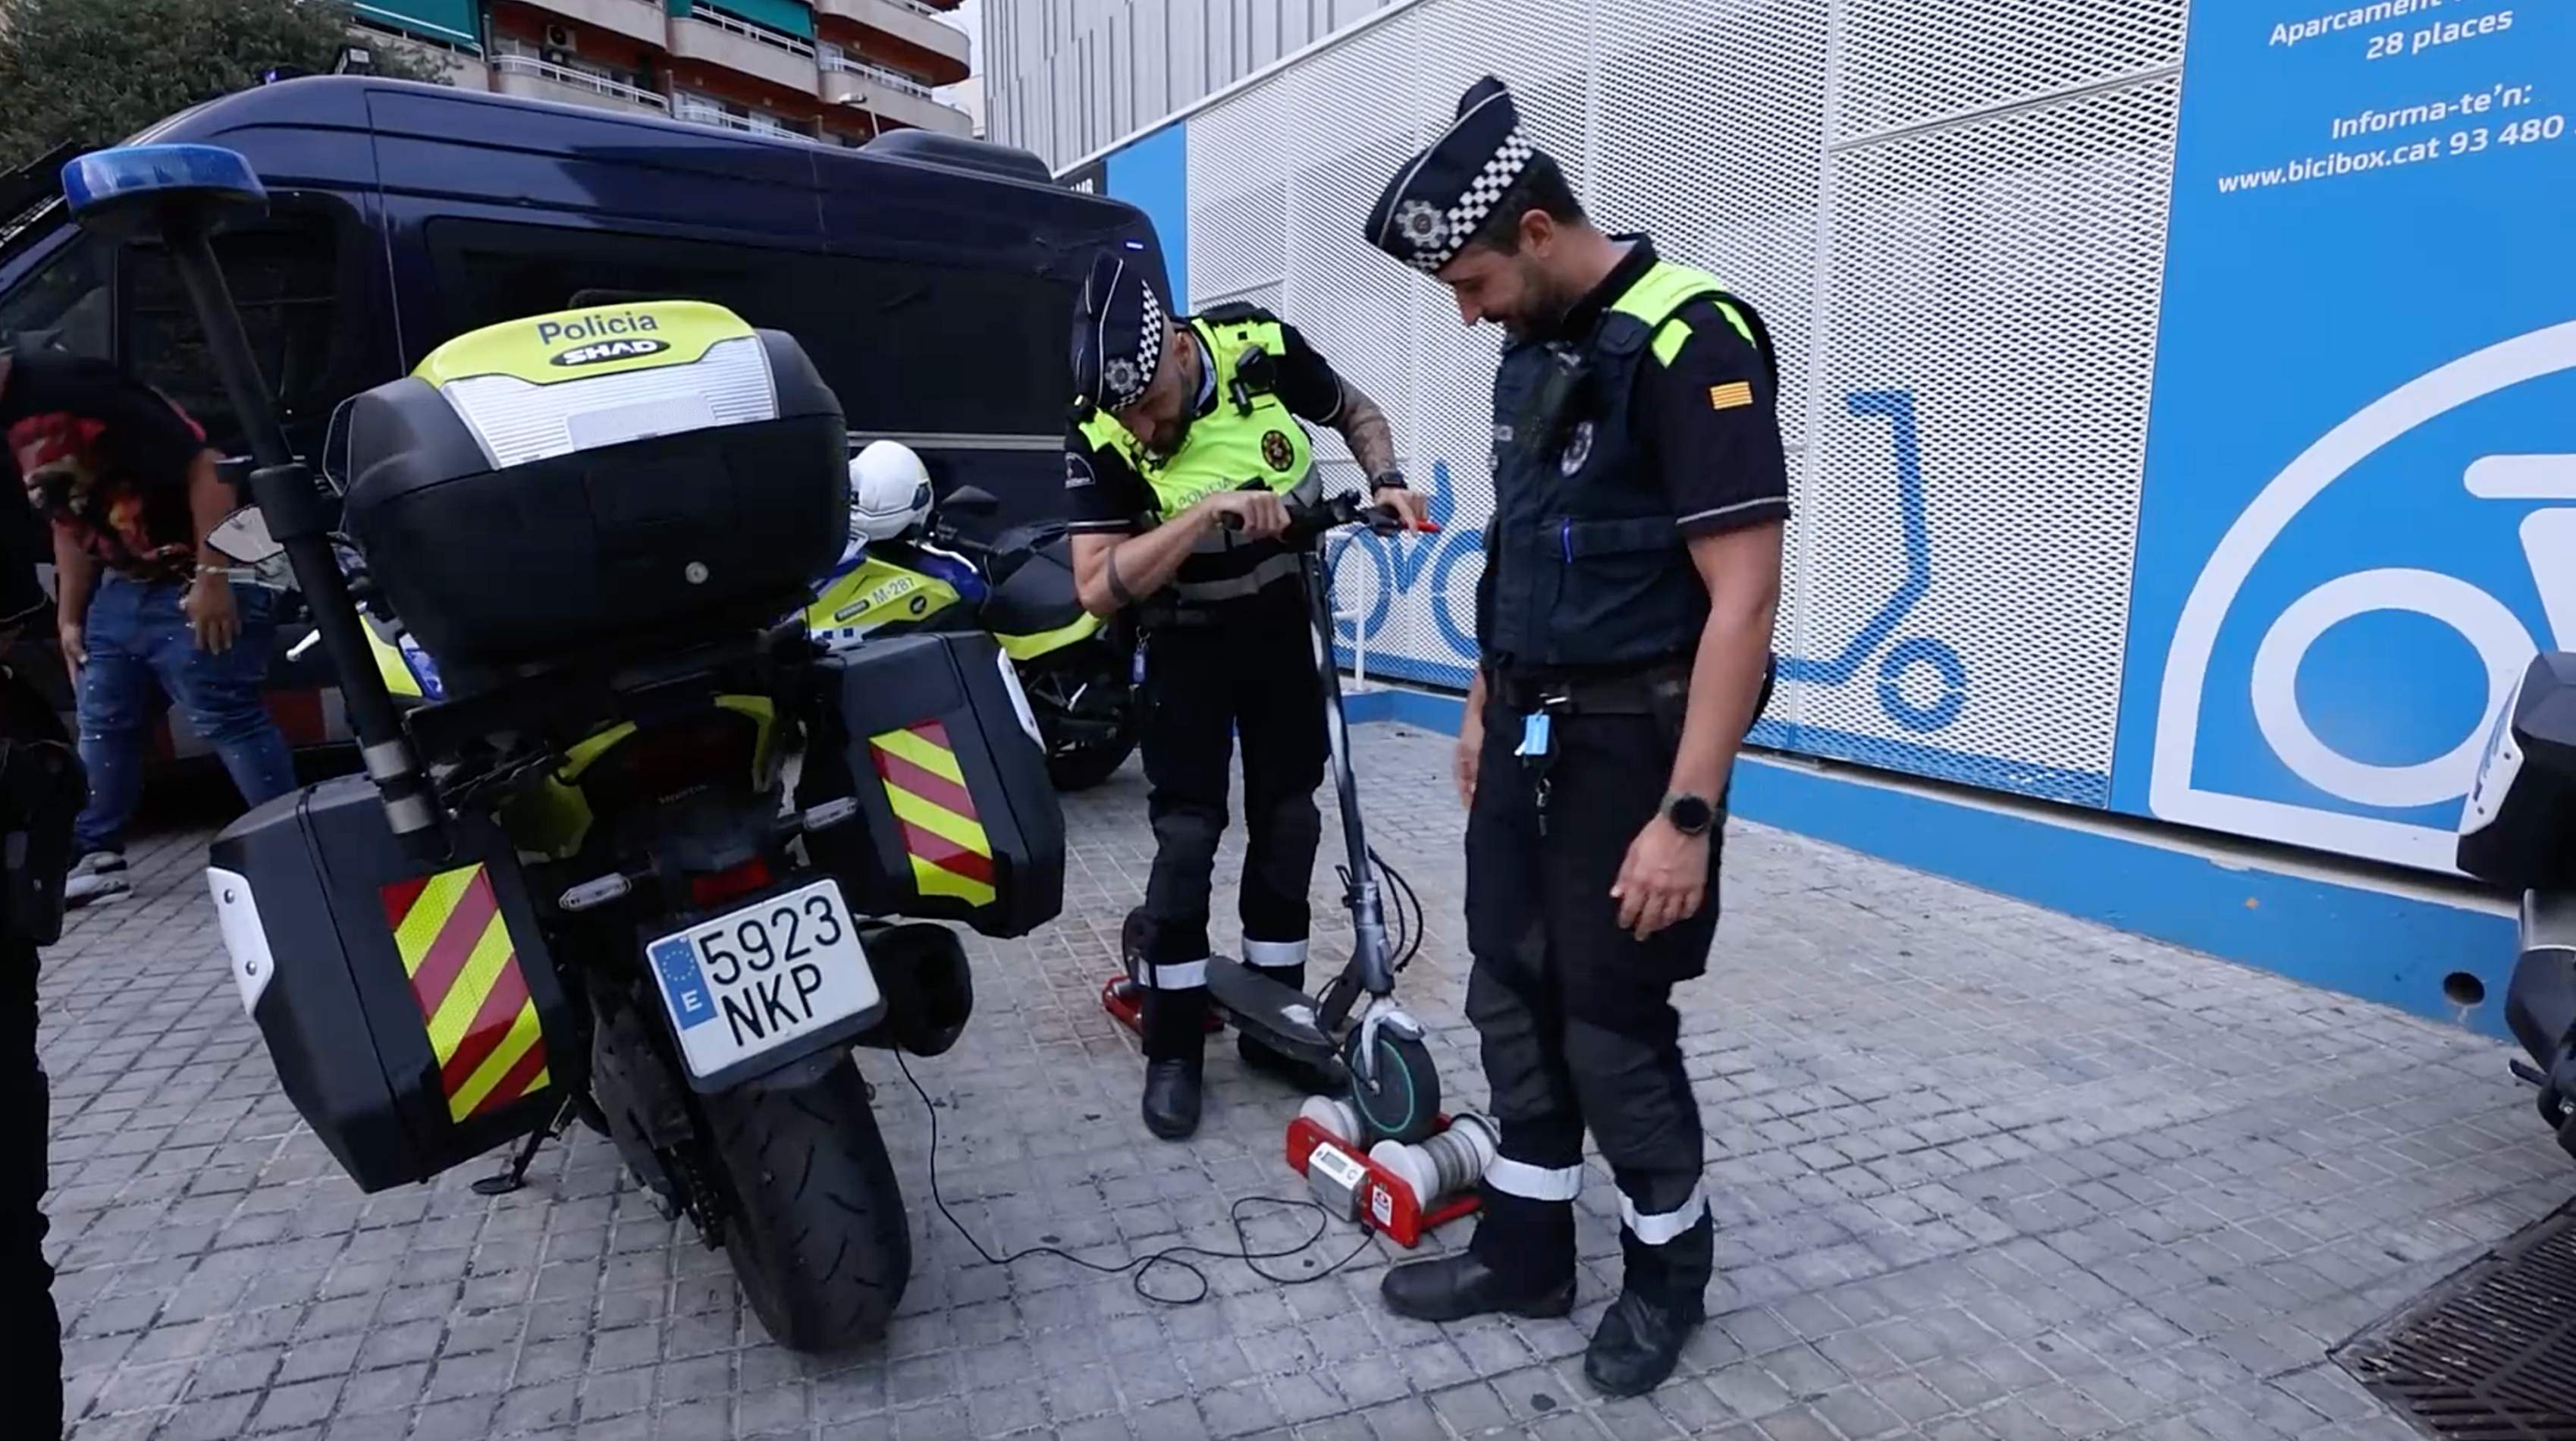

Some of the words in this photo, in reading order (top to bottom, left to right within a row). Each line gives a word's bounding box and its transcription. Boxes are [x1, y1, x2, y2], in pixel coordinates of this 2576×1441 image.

[2367, 33, 2403, 59] 28
[2411, 10, 2513, 55] places
[2218, 137, 2440, 193] www.bicibox.cat
[2449, 128, 2488, 155] 93
[2498, 115, 2565, 146] 480
[538, 312, 657, 345] Policia
[563, 341, 657, 365] SHAD
[698, 896, 841, 985] 5923
[680, 989, 702, 1012] E
[721, 963, 821, 1047] NKP
